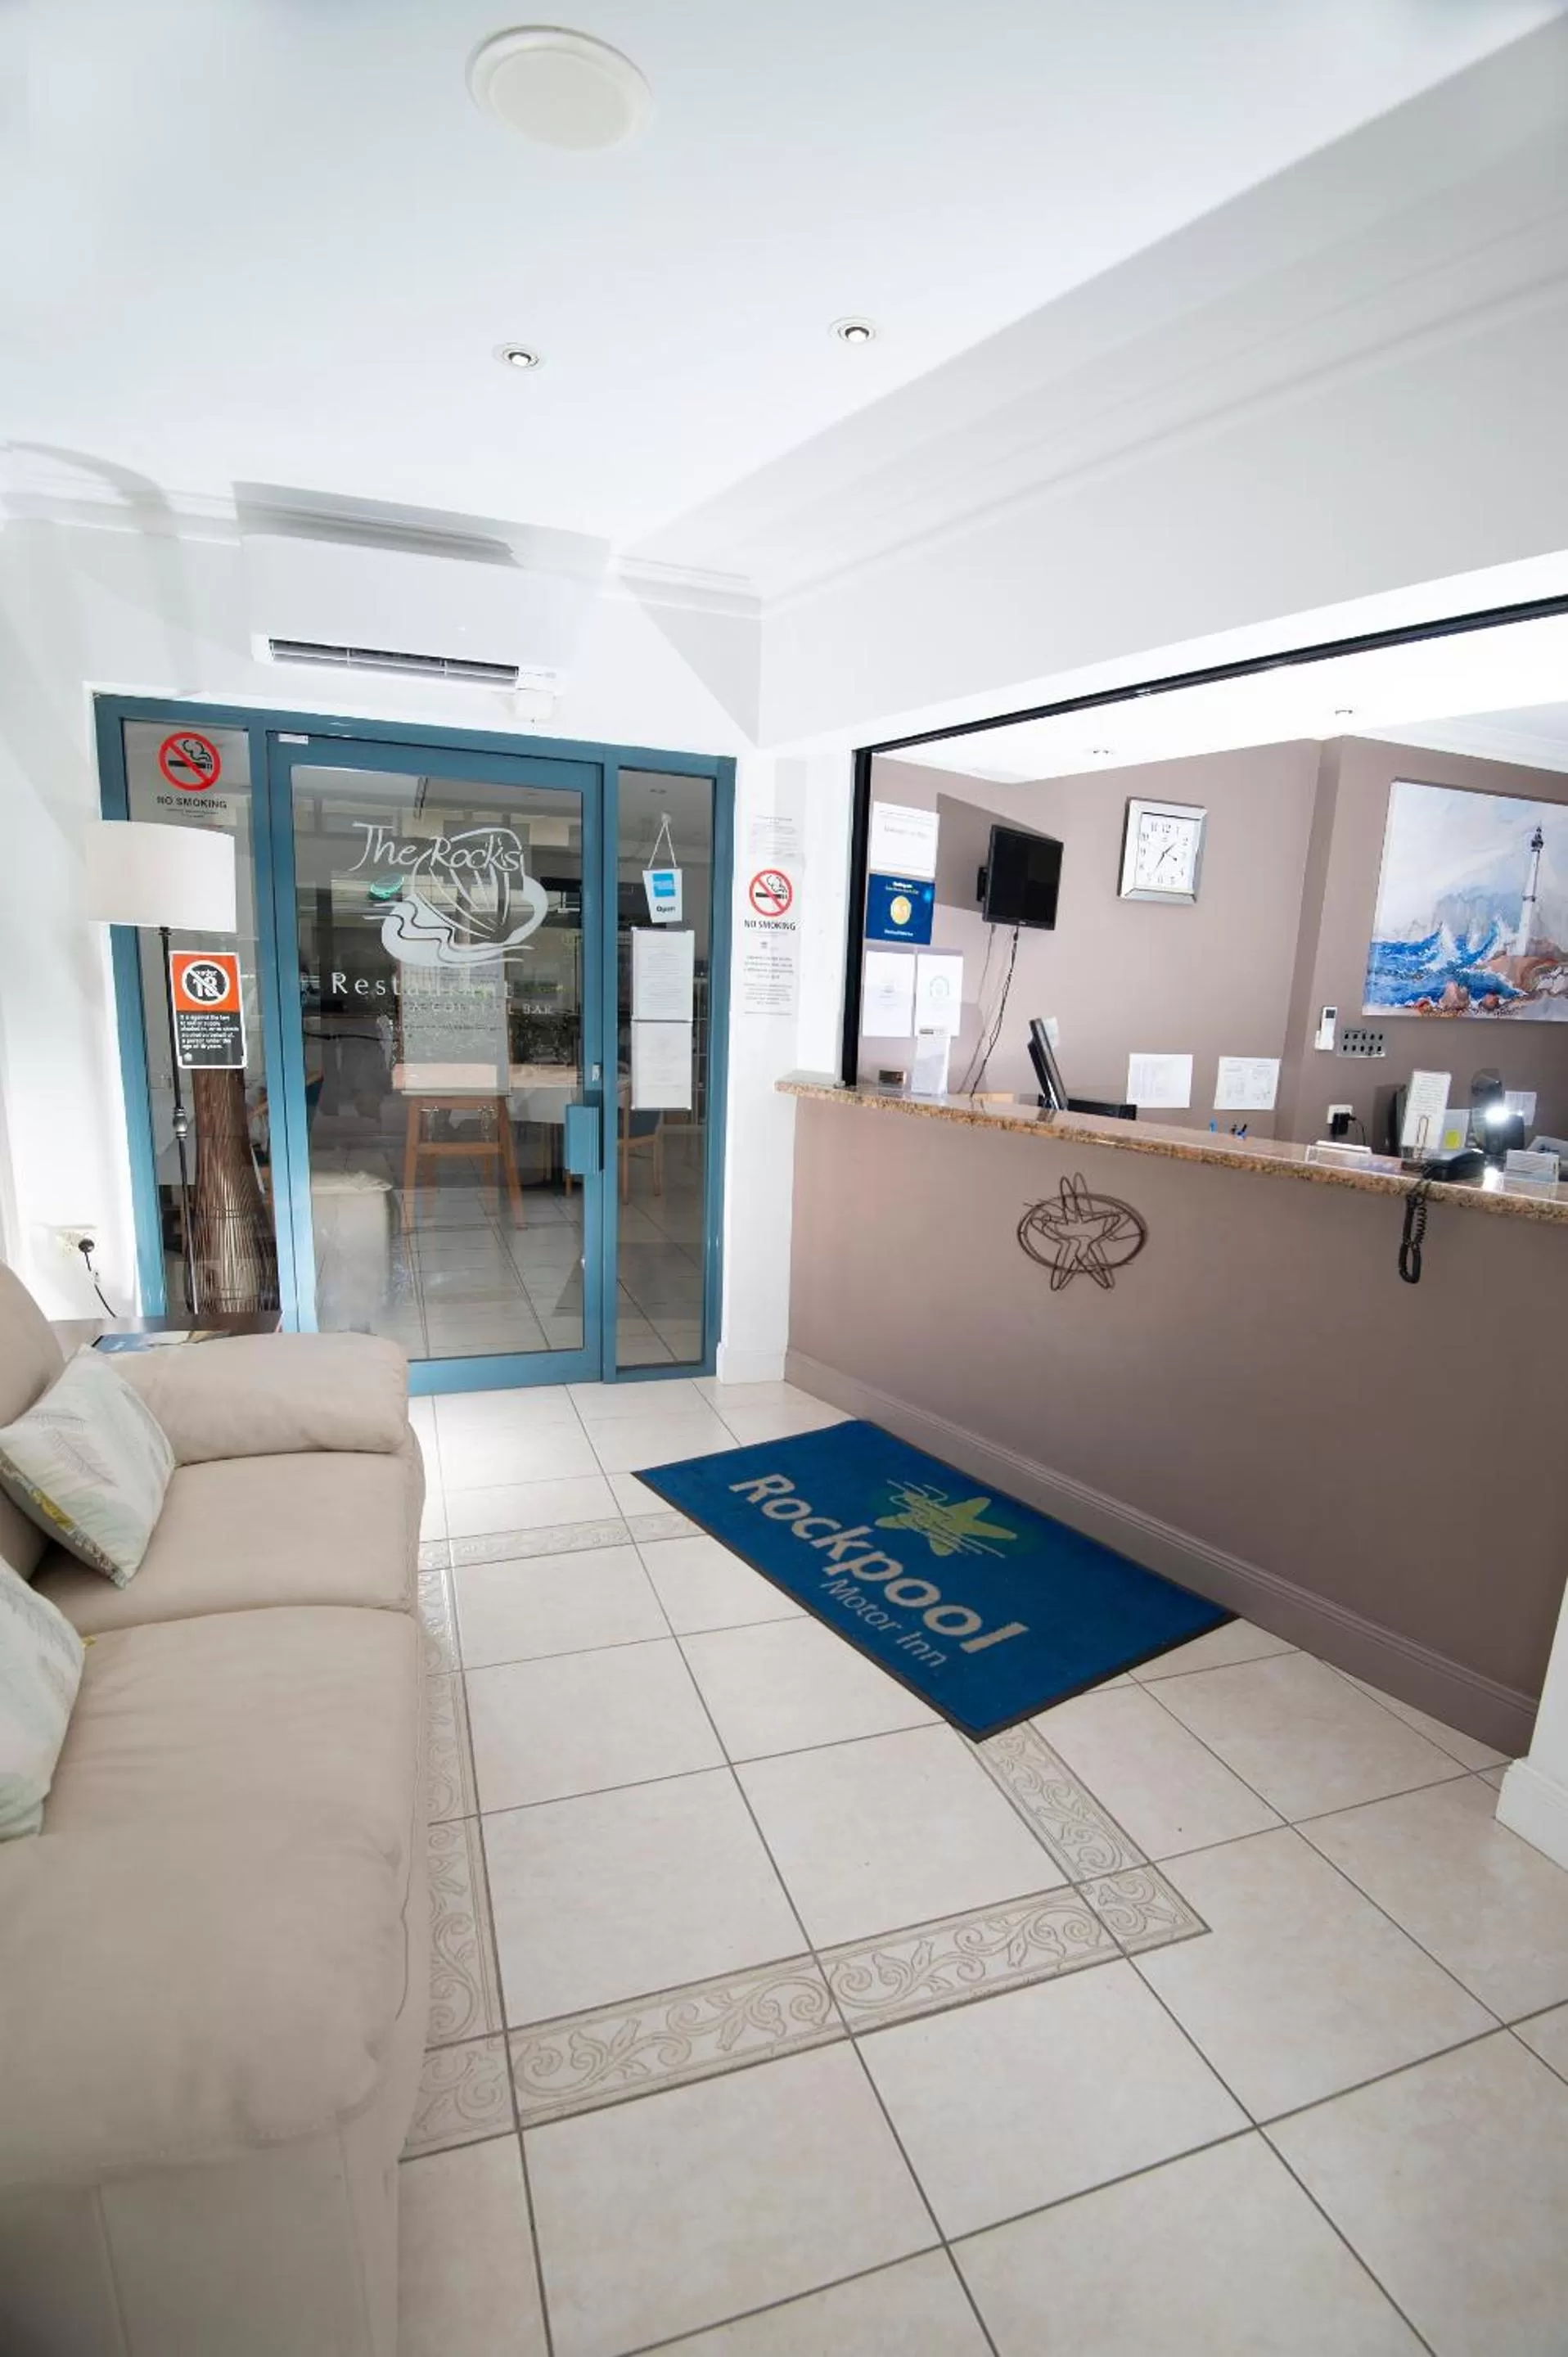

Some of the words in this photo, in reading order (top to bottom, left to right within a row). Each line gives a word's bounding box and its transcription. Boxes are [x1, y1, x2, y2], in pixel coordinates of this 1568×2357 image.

[157, 796, 173, 805] NO
[175, 797, 227, 809] SMOKING
[349, 821, 418, 871] The
[428, 834, 521, 872] Rocks
[744, 919, 756, 929] NO
[759, 920, 796, 931] SMOKING
[728, 1474, 1030, 1654] Rockpool
[821, 1579, 903, 1632] Motor
[896, 1631, 947, 1667] Inn
